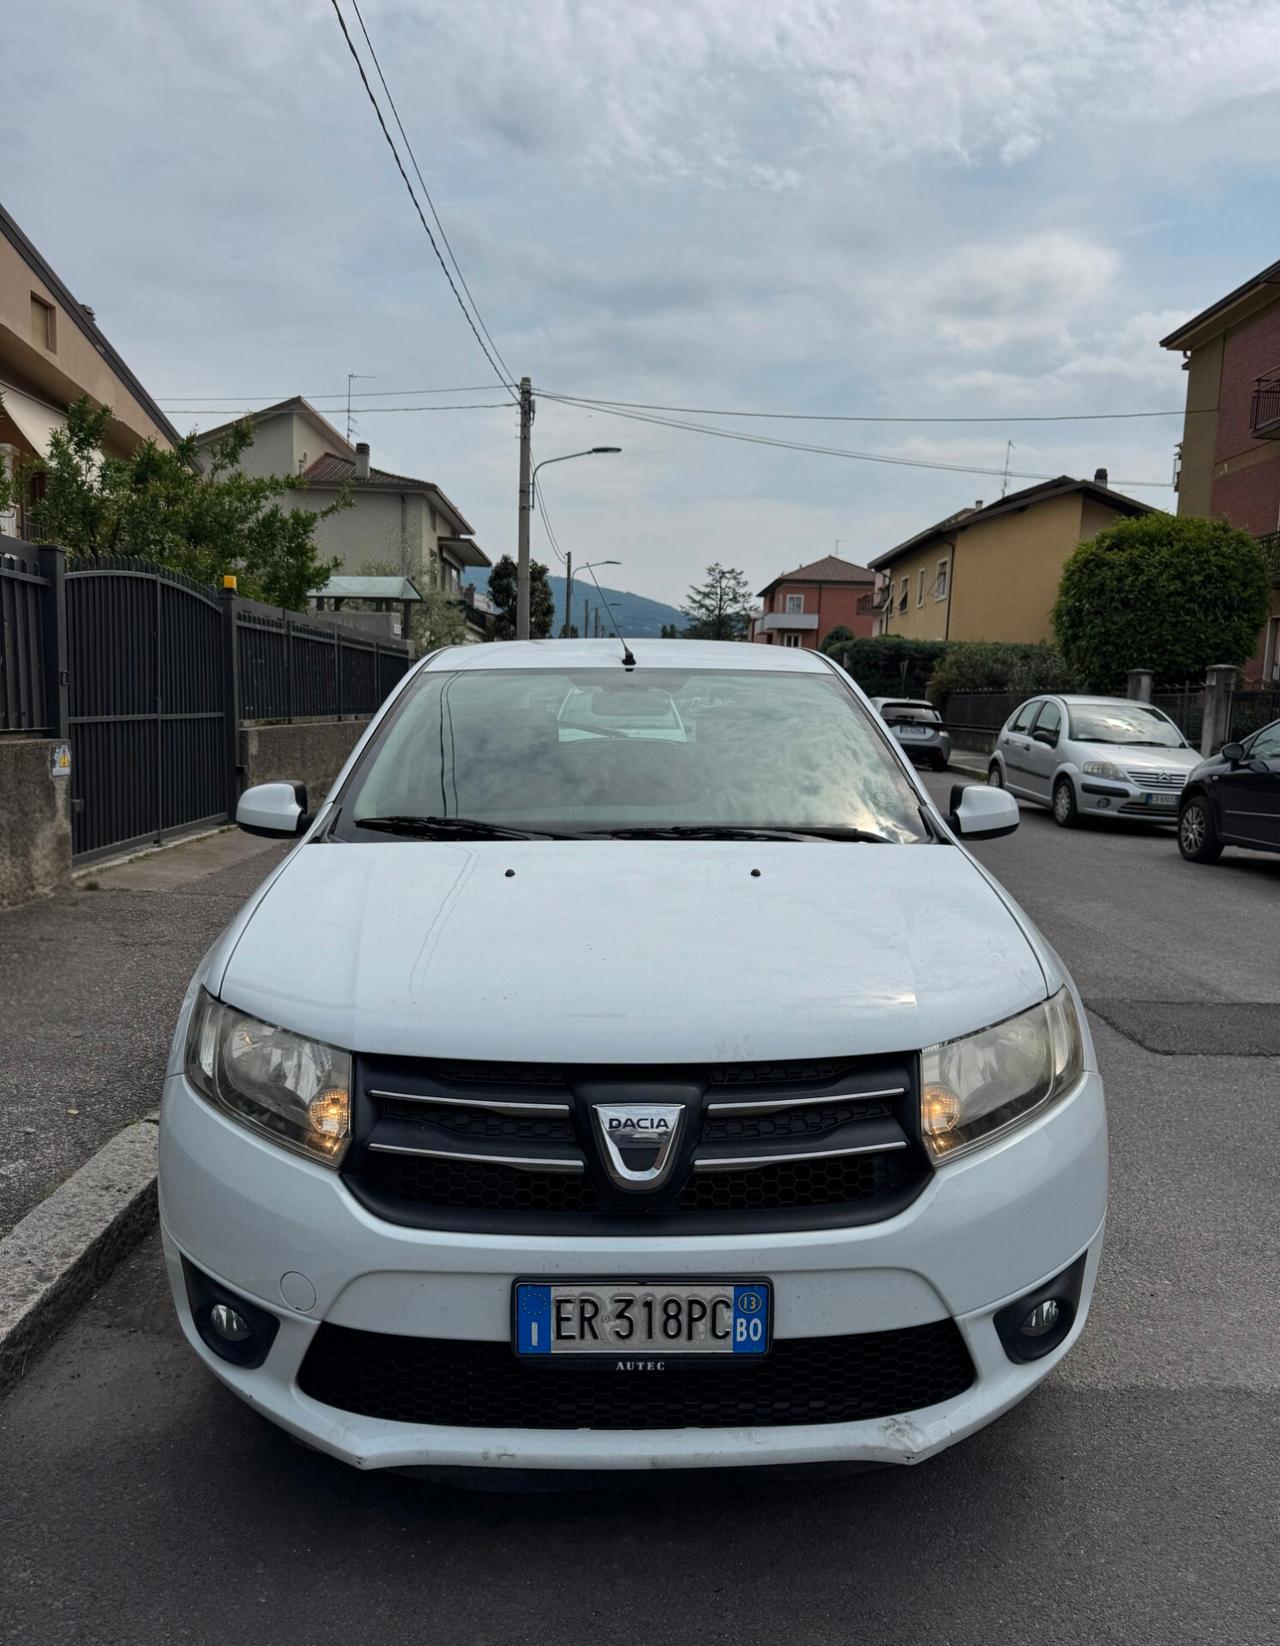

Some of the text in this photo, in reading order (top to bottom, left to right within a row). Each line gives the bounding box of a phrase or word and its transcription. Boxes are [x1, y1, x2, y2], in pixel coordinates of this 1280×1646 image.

[608, 1118, 669, 1130] DACIA
[743, 1296, 756, 1310] 13
[531, 1322, 538, 1347] I
[736, 1317, 762, 1342] BO
[616, 1361, 665, 1371] AUTEC
